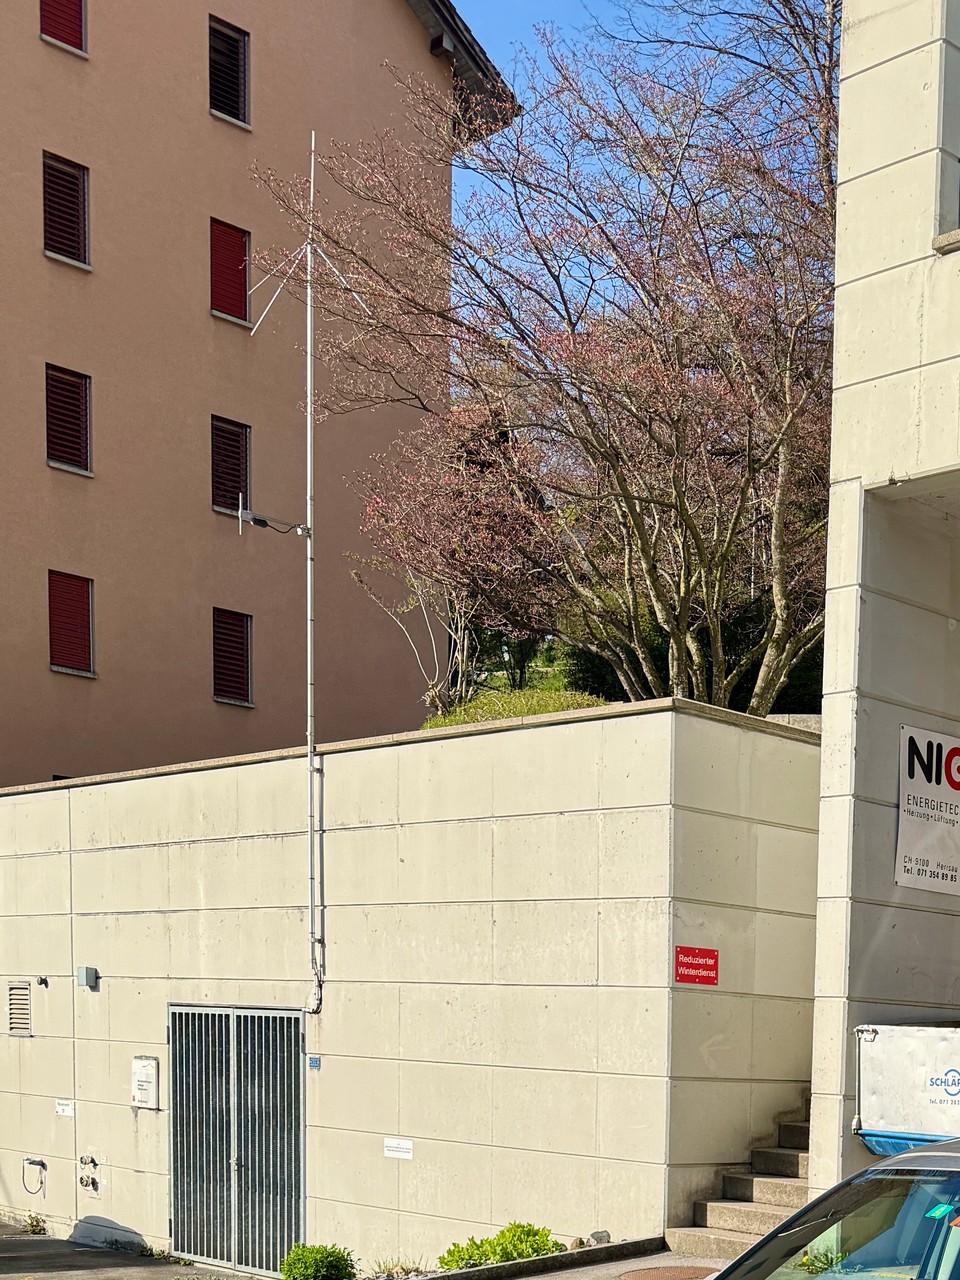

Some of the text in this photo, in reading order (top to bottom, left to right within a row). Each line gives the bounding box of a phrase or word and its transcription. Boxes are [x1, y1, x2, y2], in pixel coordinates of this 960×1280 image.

[903, 865, 915, 875] Tel.
[917, 868, 927, 877] 071
[929, 870, 940, 879] 354
[941, 872, 949, 881] 89
[678, 954, 715, 965] Reduzierter
[677, 966, 716, 977] Winterdienst
